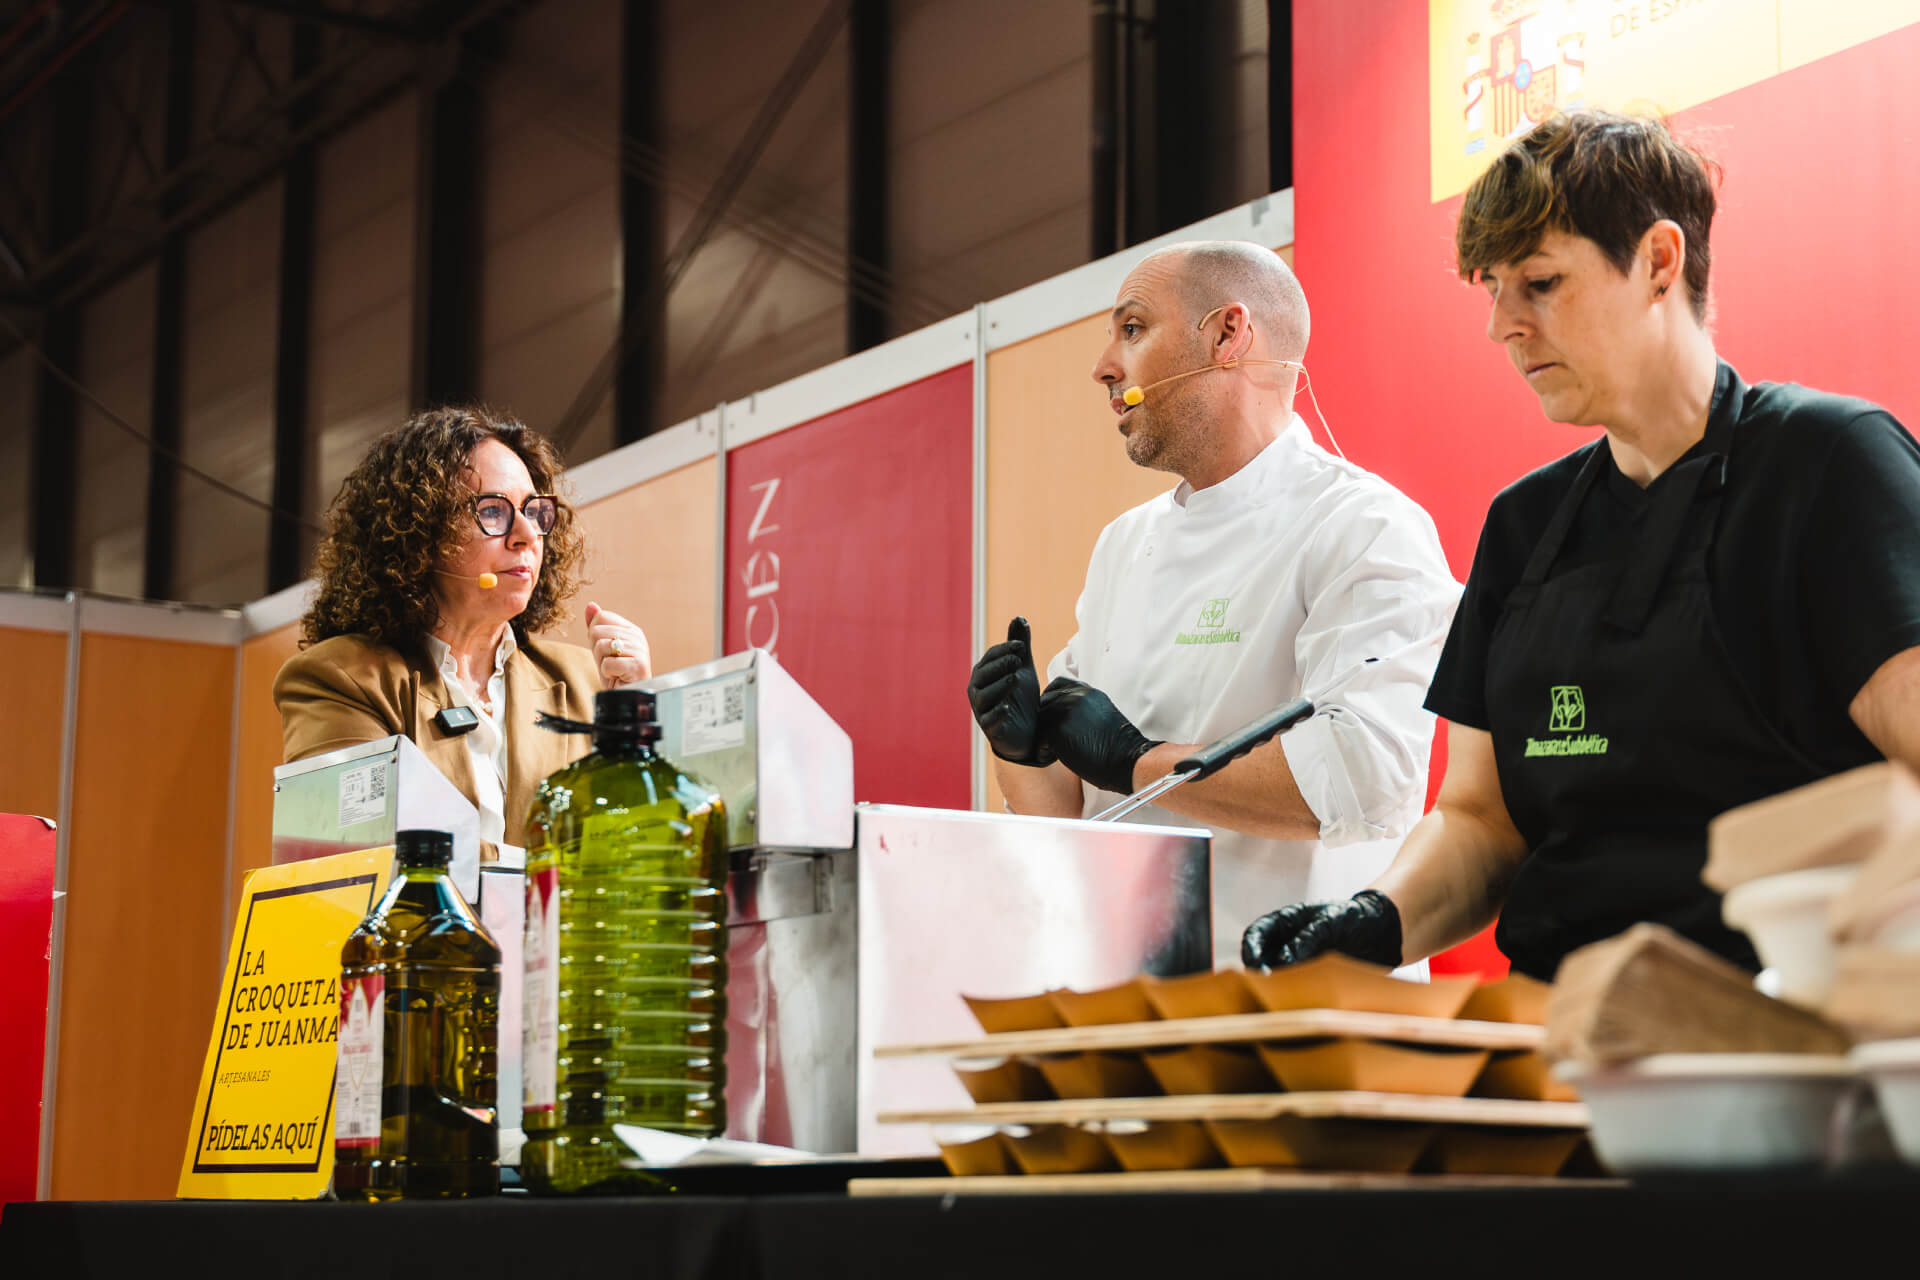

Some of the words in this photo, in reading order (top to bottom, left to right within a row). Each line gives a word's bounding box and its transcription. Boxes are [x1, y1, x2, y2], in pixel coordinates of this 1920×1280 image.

[1609, 6, 1640, 38] DE
[742, 477, 781, 660] CÉN
[243, 950, 264, 976] LA
[236, 978, 336, 1013] CROQUETA
[226, 1023, 252, 1050] DE
[255, 1016, 338, 1048] JUANMA
[219, 1070, 271, 1084] ARTESANALES
[206, 1119, 272, 1151] PÍDELAS
[270, 1115, 319, 1154] AQUÍ
